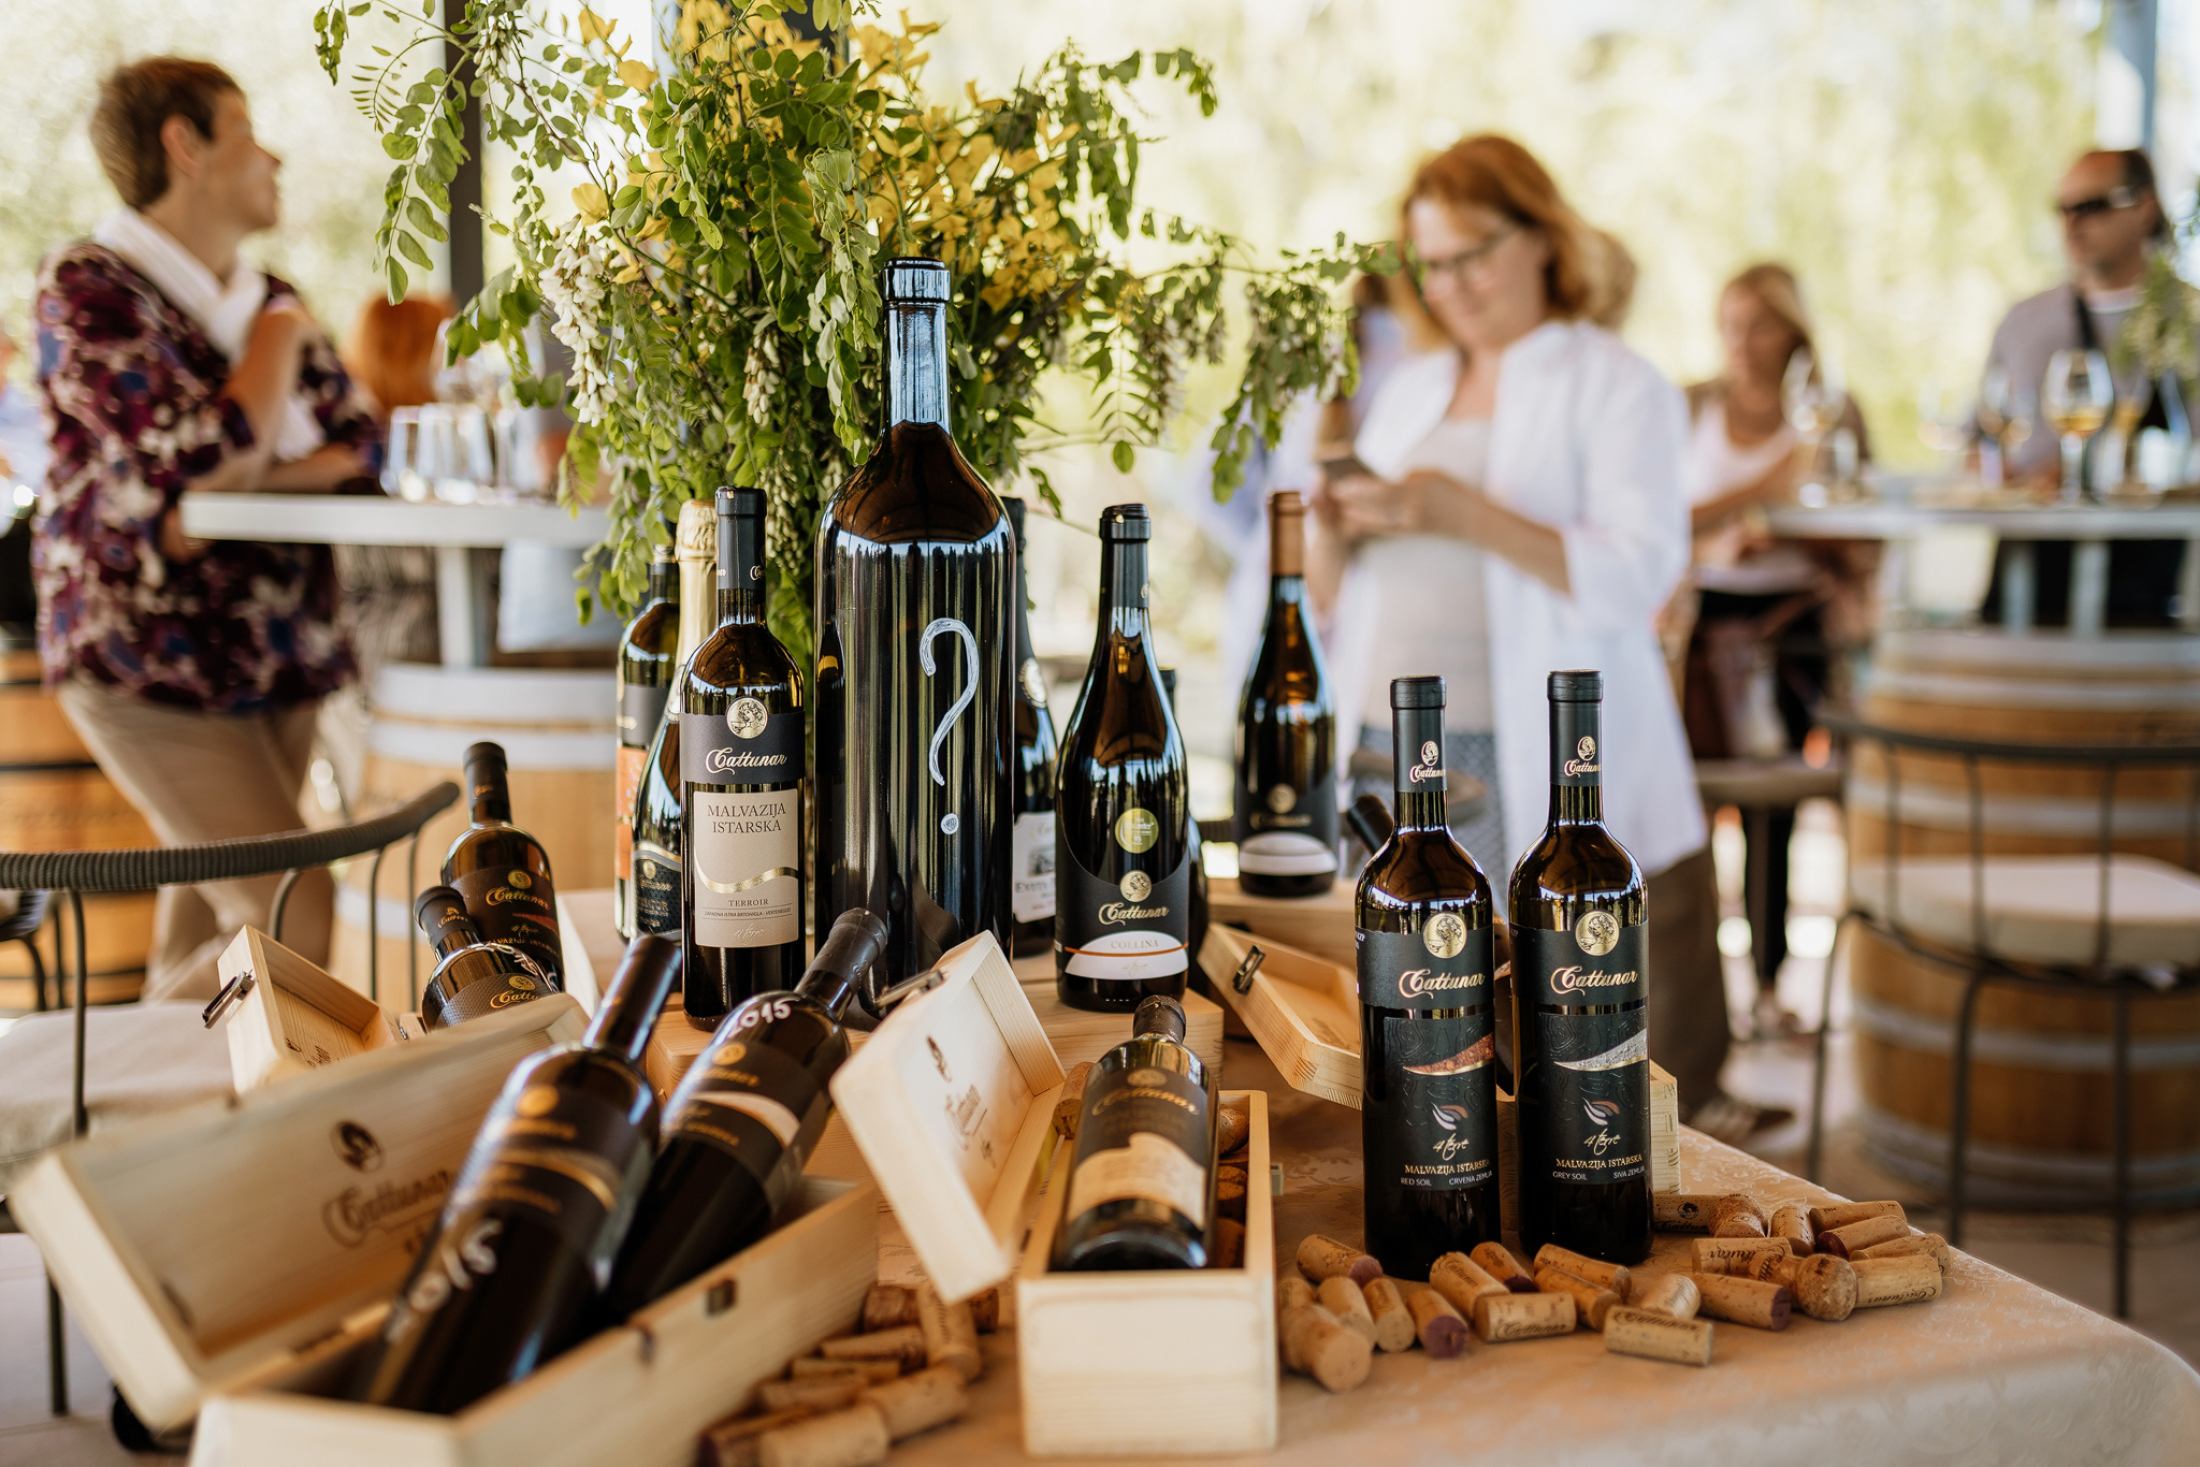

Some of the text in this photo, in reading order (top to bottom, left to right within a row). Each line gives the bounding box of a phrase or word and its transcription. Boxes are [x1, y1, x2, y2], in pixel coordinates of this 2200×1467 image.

[705, 747, 787, 775] Cattunar
[707, 802, 786, 818] MALVAZIJA
[713, 819, 782, 833] ISTARSKA
[727, 898, 769, 908] TERROIR
[1098, 902, 1170, 926] Cattunar
[1398, 968, 1486, 999] Cattunar
[1550, 965, 1638, 996] Cattunar
[1555, 1154, 1643, 1170] MALVAZIJA ISTARSKA
[1404, 1164, 1456, 1176] MALVAZIJA
[1552, 1170, 1588, 1181] GREY SOIL
[1400, 1177, 1433, 1187] RED SOIL
[1448, 1175, 1475, 1186] CRVENA
